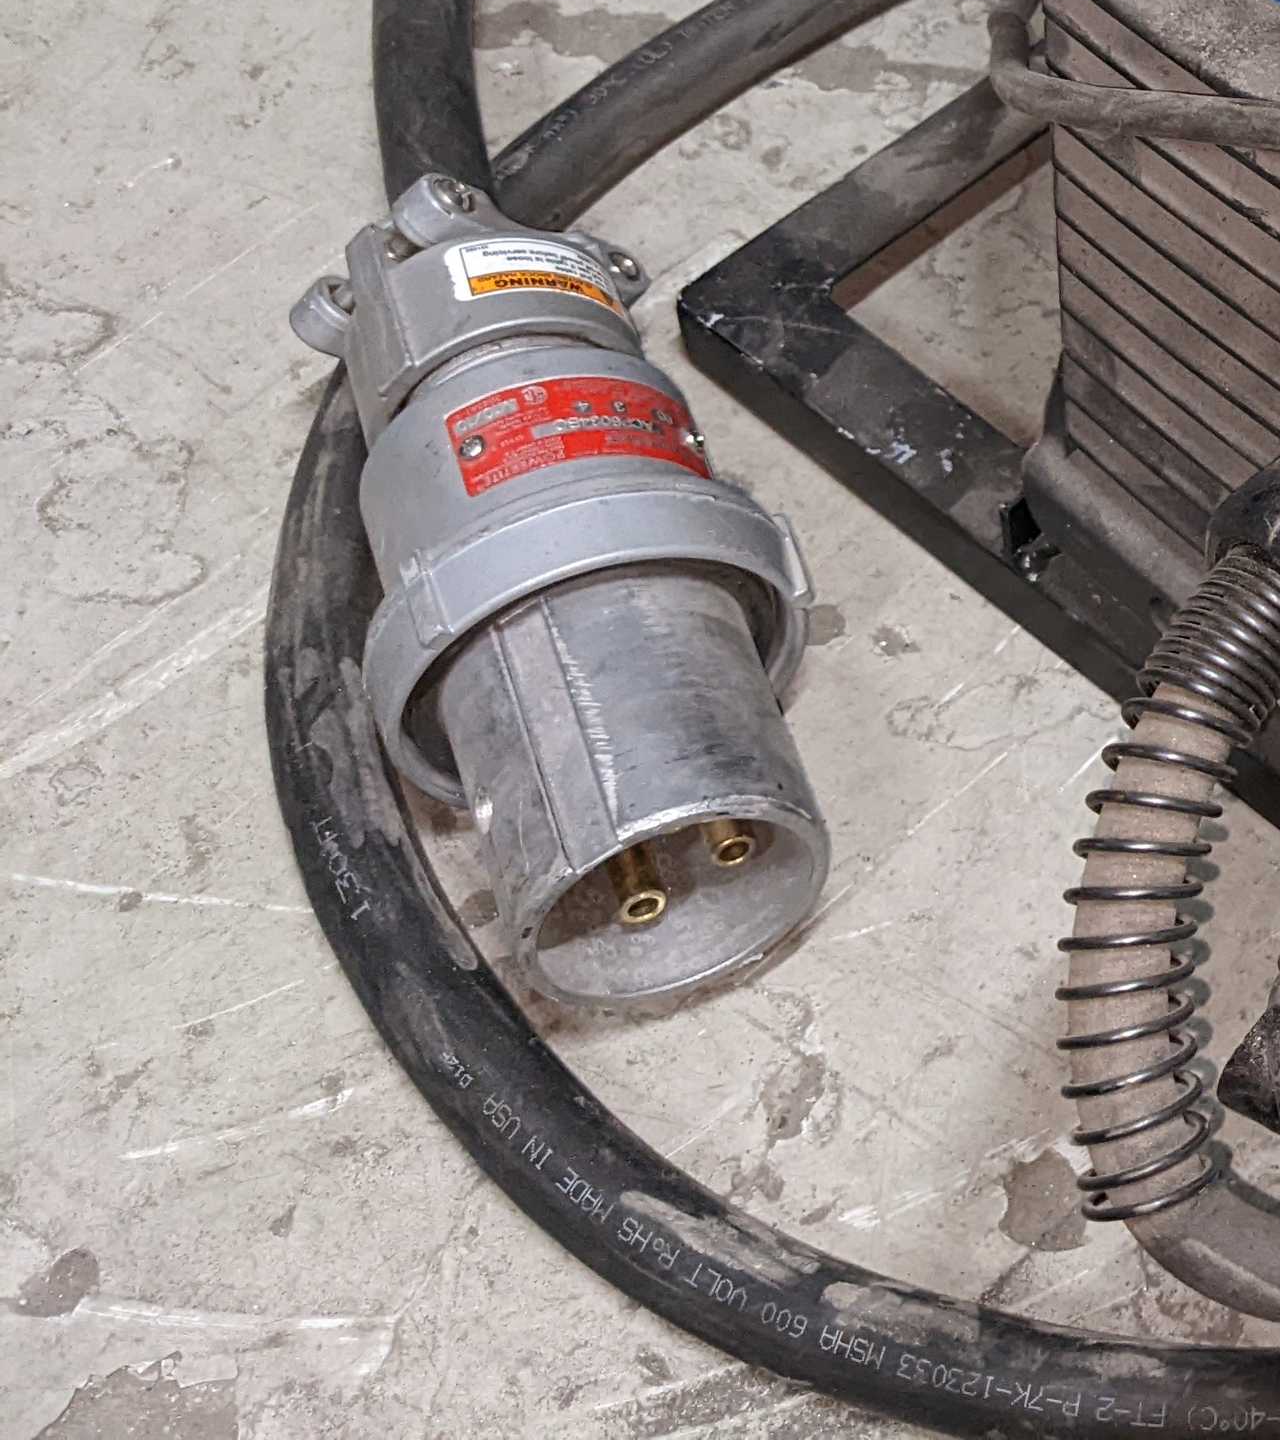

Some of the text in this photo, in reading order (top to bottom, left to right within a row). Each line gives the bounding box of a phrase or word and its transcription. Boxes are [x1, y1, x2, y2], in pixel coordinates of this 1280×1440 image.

[495, 277, 585, 293] WARNING
[478, 1090, 523, 1140] USA
[519, 1134, 552, 1171] IN
[552, 1165, 616, 1223] MADE
[615, 1215, 681, 1269] RoHS
[683, 1260, 750, 1309] VOLT
[756, 1298, 809, 1340] 600
[814, 1322, 887, 1368] MSHA
[896, 1351, 1080, 1417] P-7K-123033
[1094, 1395, 1165, 1425] FT-2
